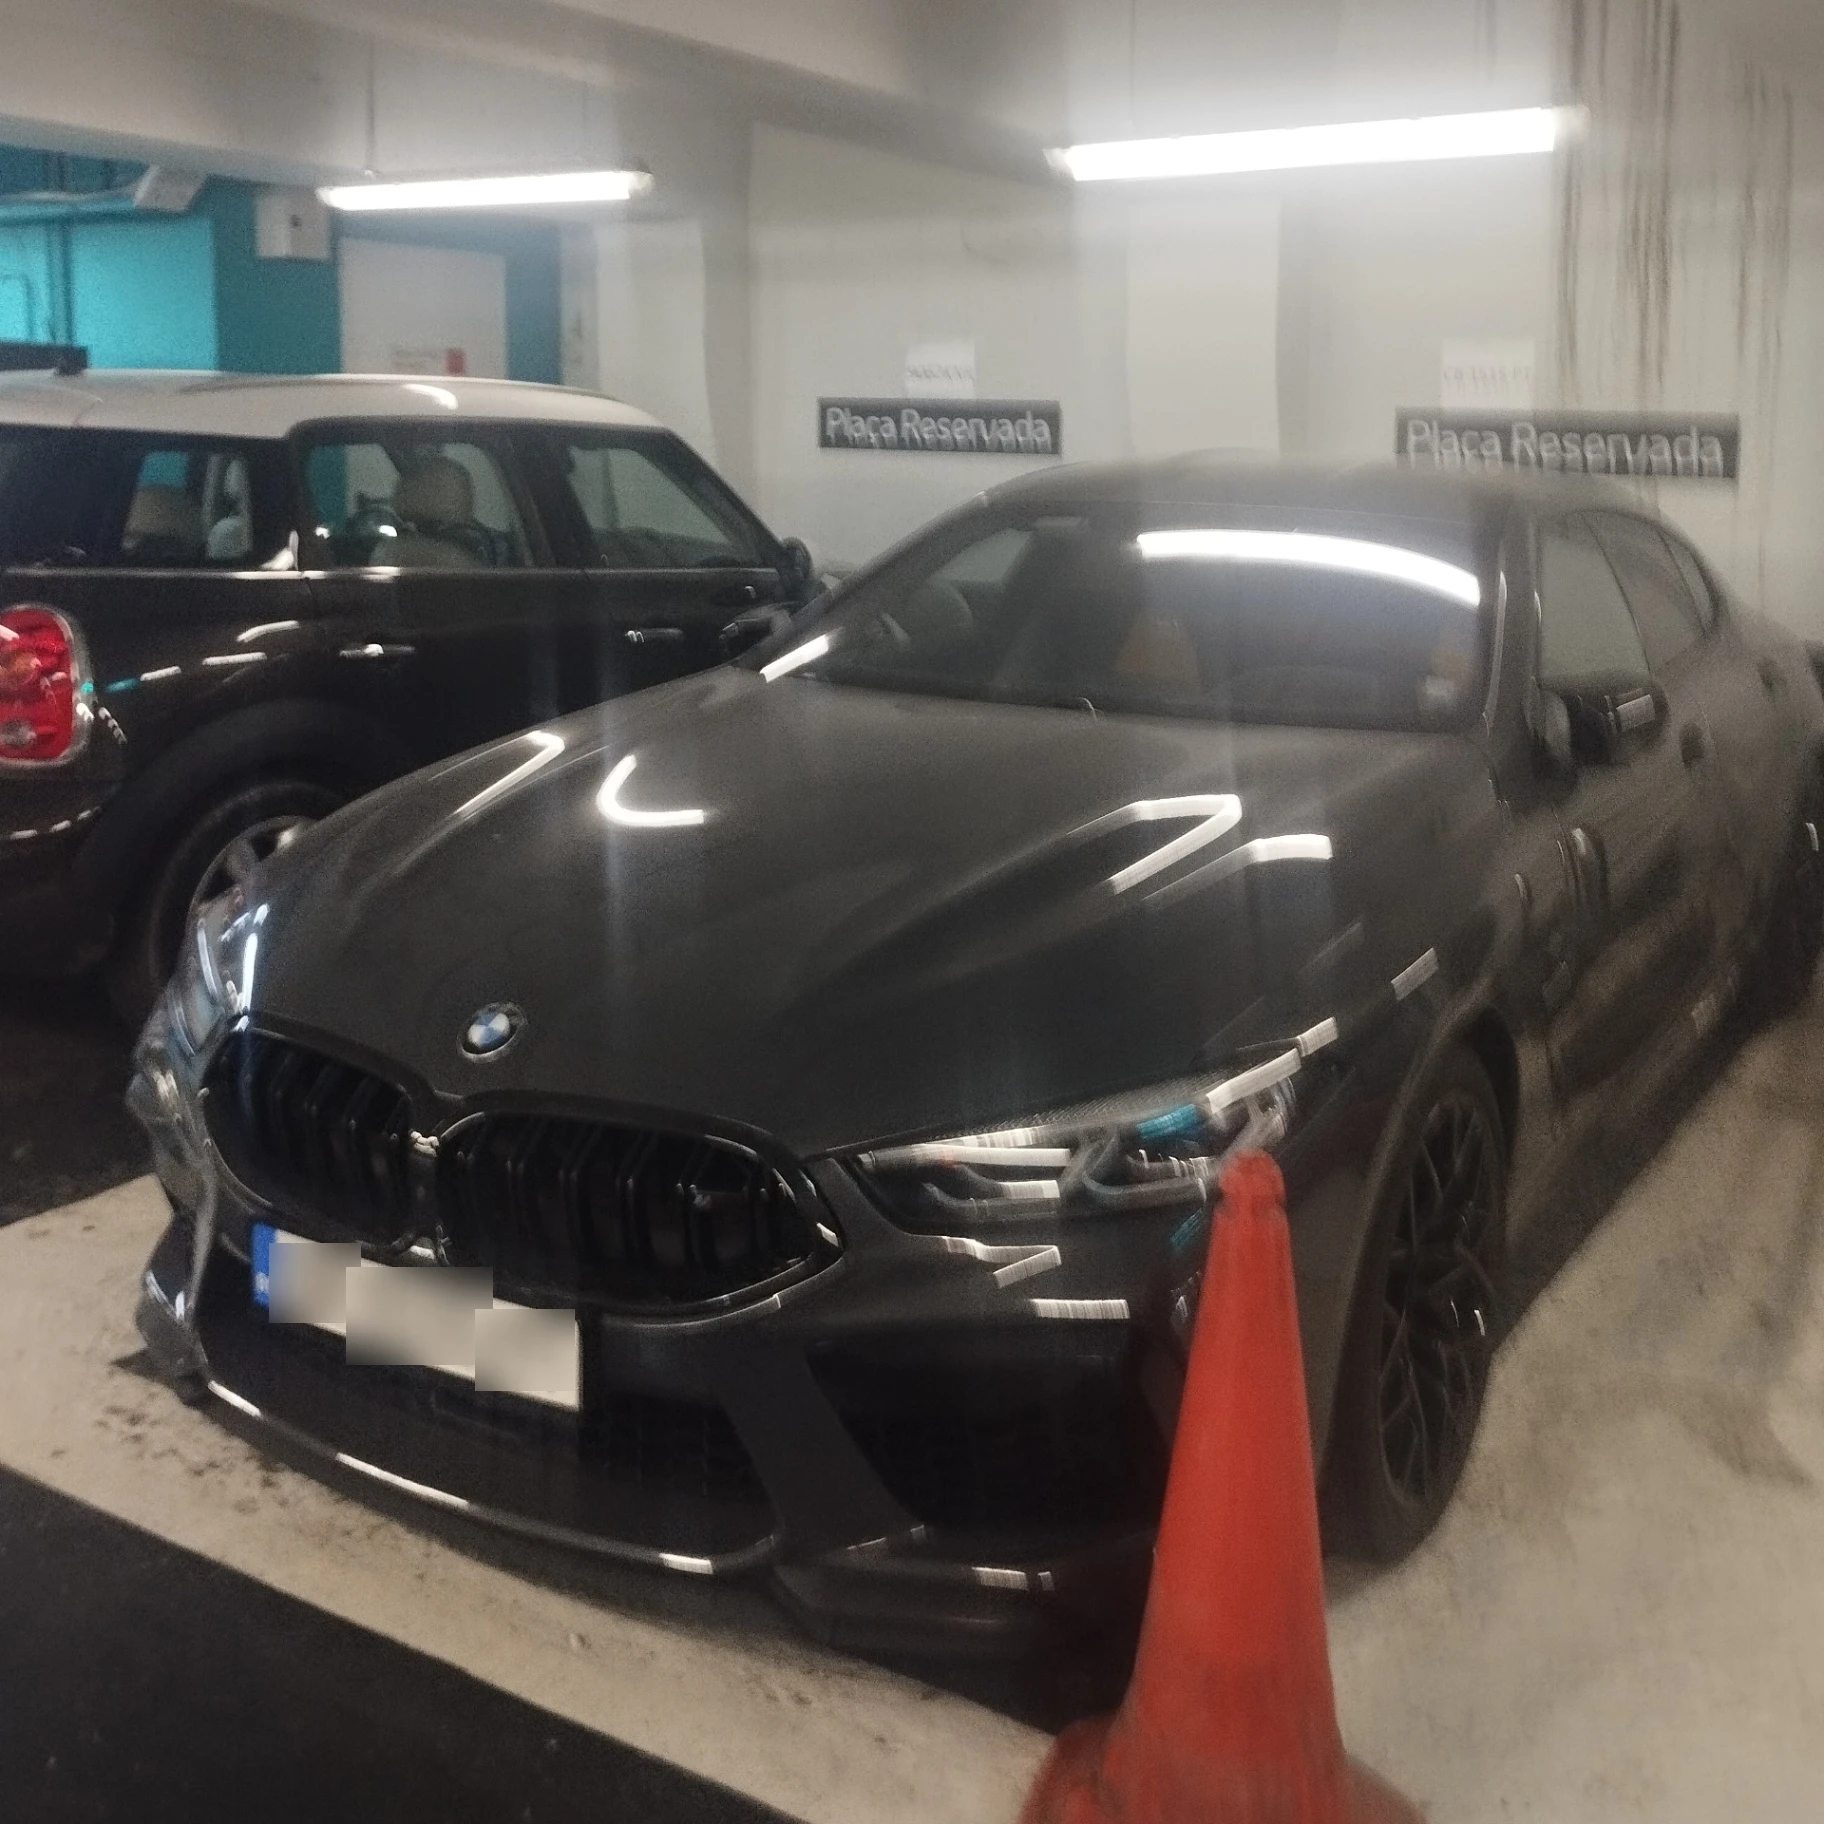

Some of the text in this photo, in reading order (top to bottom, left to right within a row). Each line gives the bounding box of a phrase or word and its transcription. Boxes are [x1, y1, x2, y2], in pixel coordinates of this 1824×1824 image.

[826, 406, 1051, 449] Plaça Reservada
[1511, 421, 1724, 476] Reservada
